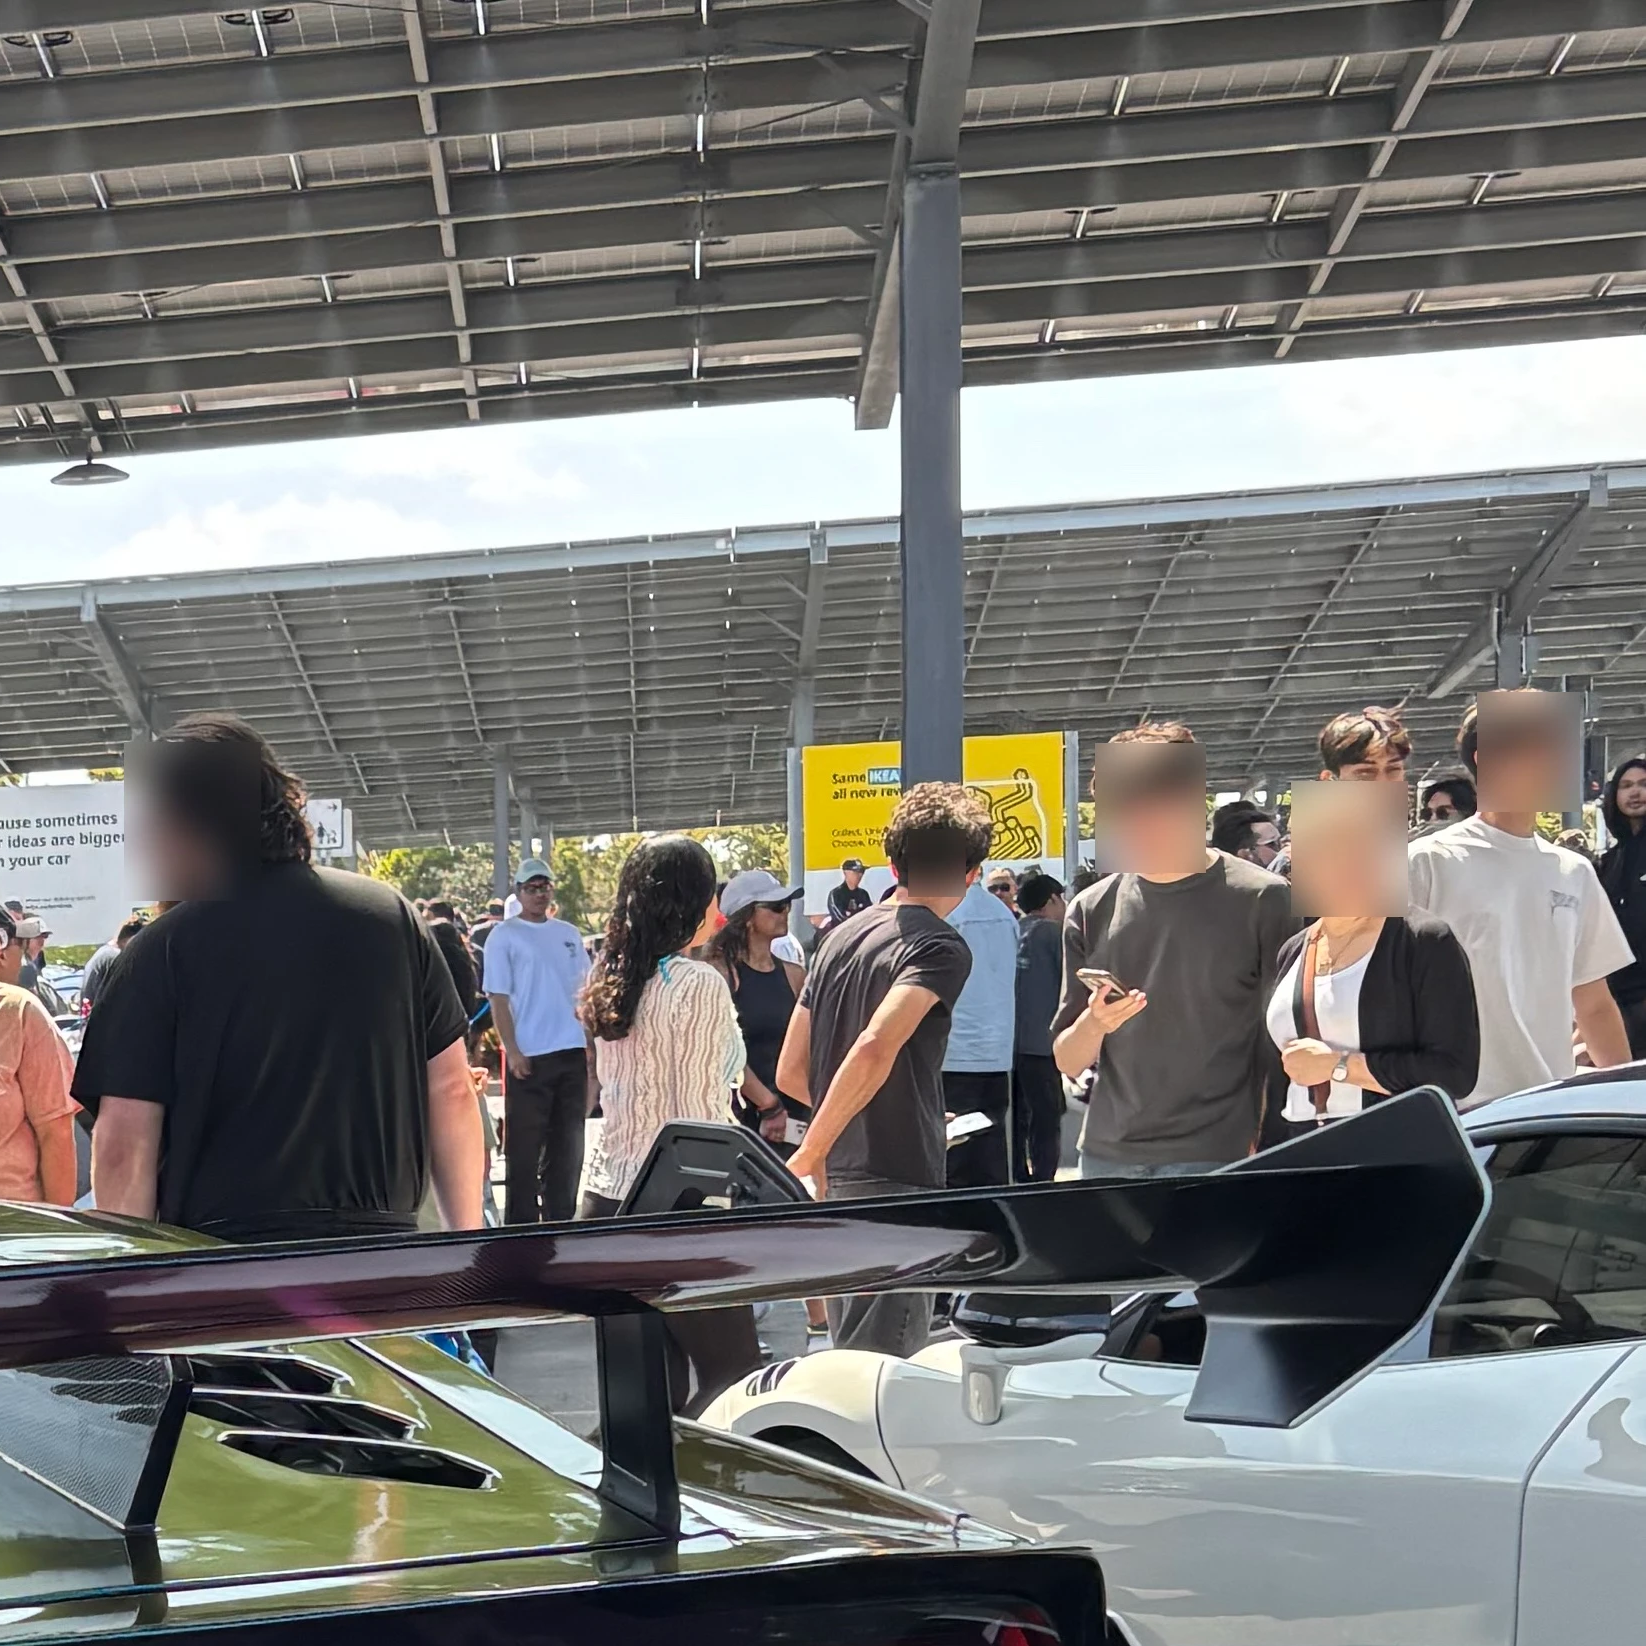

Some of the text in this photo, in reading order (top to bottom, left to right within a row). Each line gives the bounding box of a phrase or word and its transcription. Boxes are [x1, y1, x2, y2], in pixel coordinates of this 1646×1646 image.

[869, 769, 901, 783] IKEA
[35, 812, 118, 829] sometimes
[7, 834, 47, 848] ideas
[51, 836, 75, 847] are
[9, 856, 44, 870] your
[47, 854, 71, 866] car
